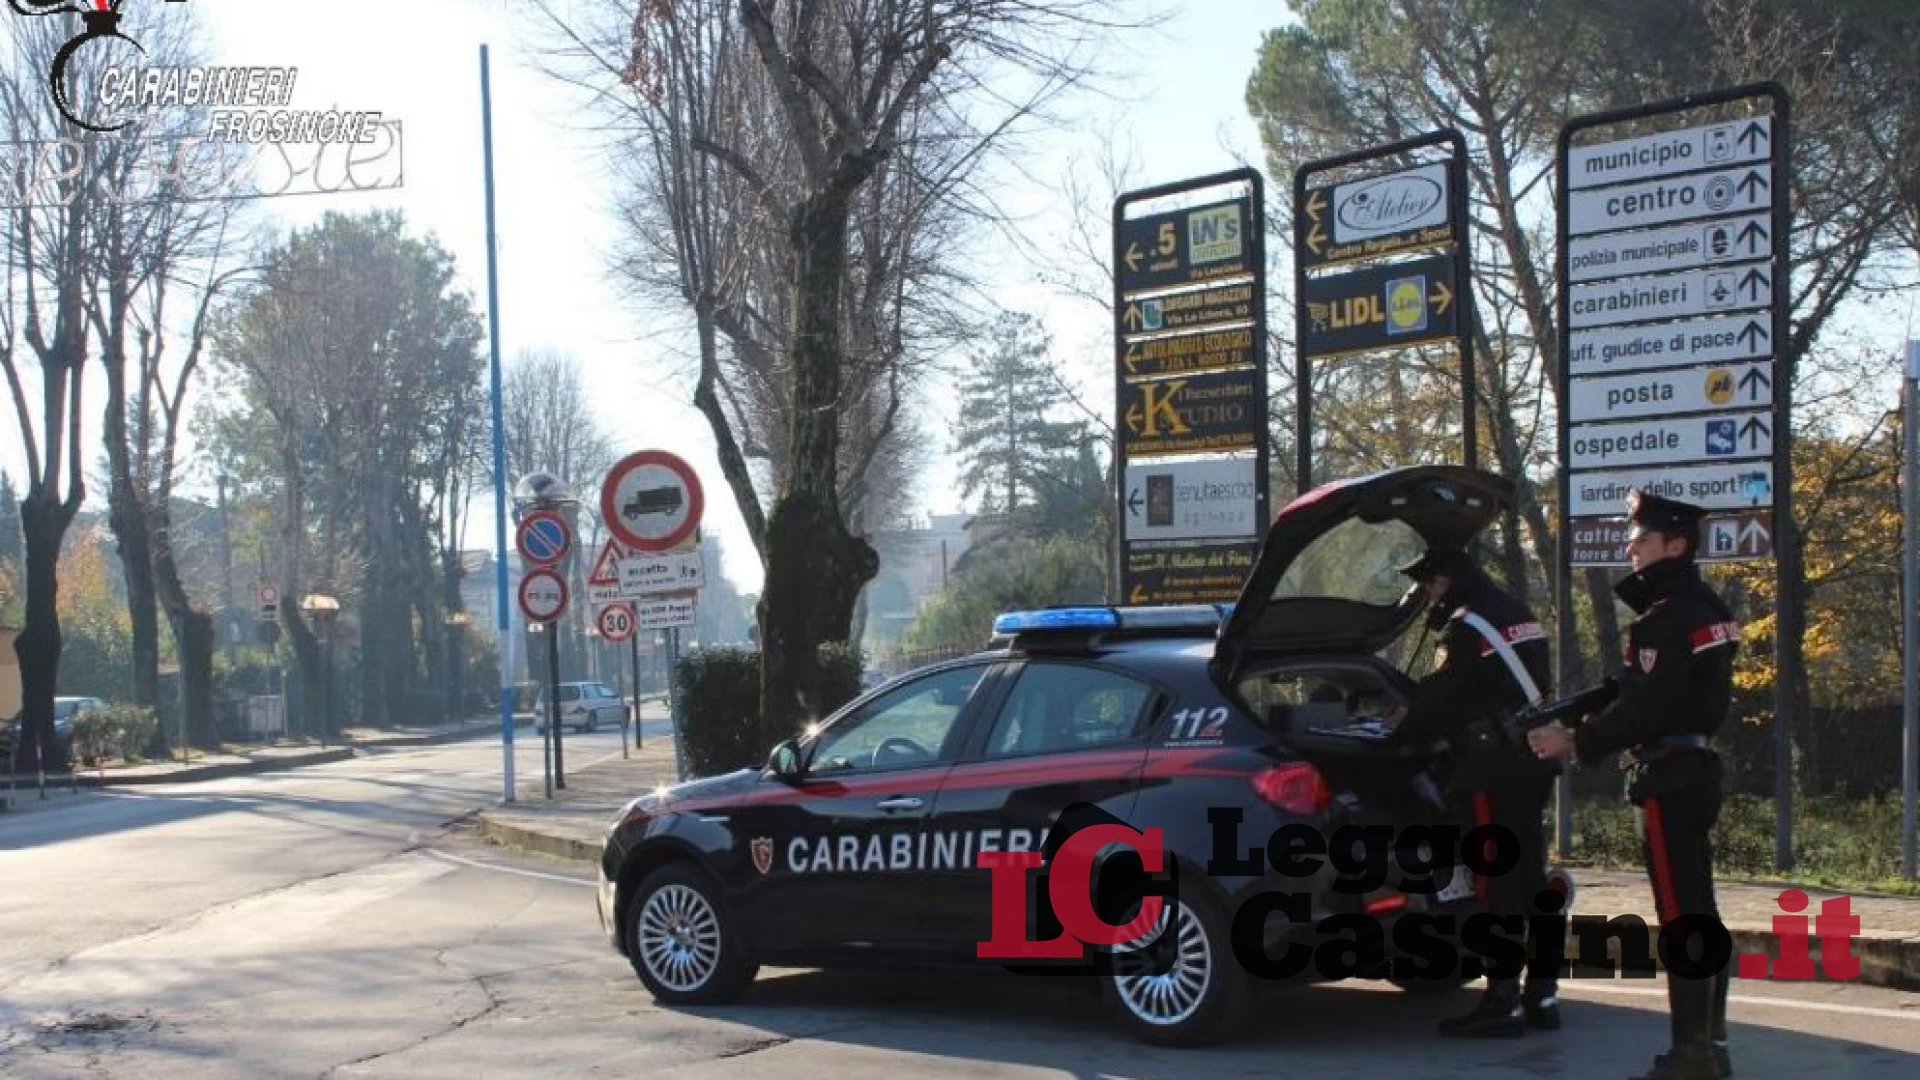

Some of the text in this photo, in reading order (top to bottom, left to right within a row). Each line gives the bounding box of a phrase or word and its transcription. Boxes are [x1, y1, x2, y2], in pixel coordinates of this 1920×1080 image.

[1585, 140, 1692, 173] municipio
[1606, 186, 1695, 217] centro
[1571, 237, 1698, 272] polizia municipale
[1330, 296, 1384, 328] LIDL
[1573, 282, 1687, 315] carabinieri
[1602, 338, 1664, 363] giudice
[1669, 333, 1685, 350] di
[1691, 331, 1735, 354] pace
[1607, 382, 1674, 410] posta
[1573, 429, 1680, 458] ospedale
[1689, 474, 1736, 497] sport
[606, 614, 627, 632] 30
[1170, 706, 1229, 738] 112
